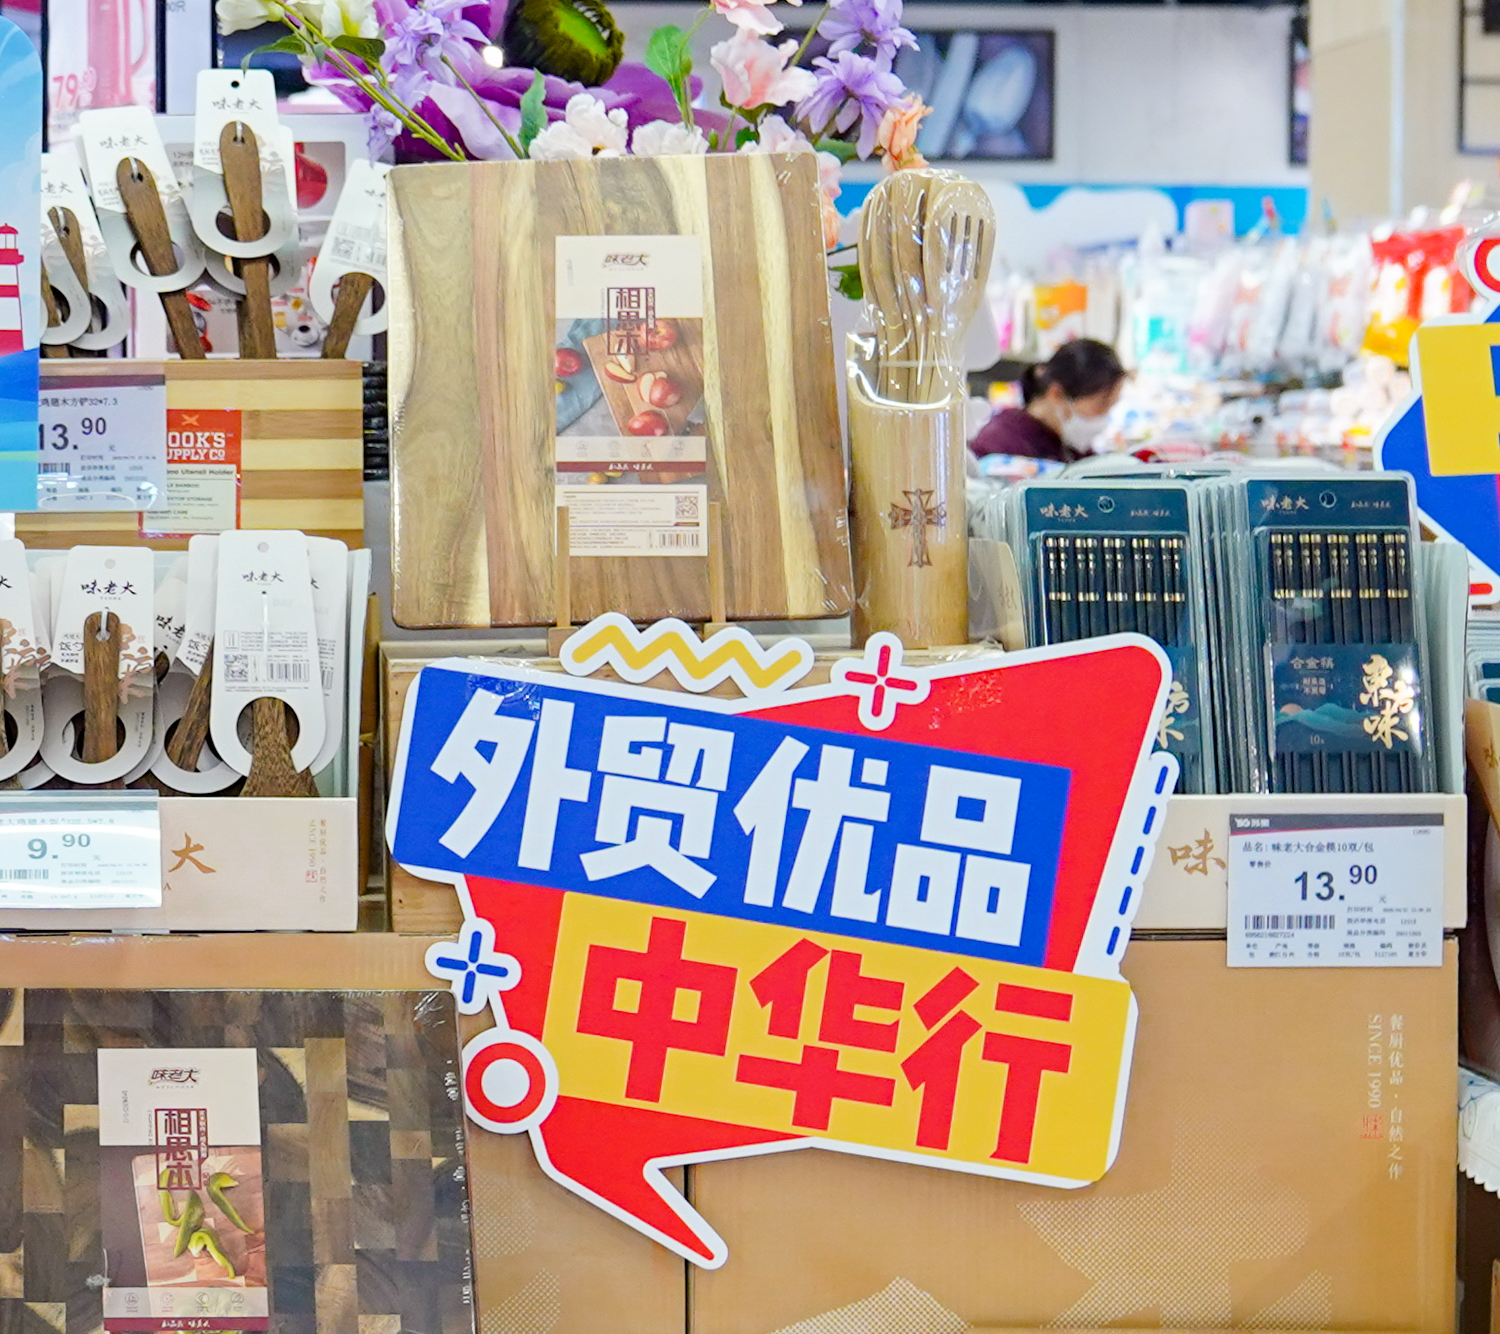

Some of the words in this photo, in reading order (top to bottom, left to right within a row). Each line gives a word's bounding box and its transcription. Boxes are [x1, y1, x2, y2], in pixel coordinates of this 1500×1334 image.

[212, 96, 263, 112] 味老大
[99, 136, 148, 149] 味老大
[1039, 502, 1089, 520] 味老大
[1260, 495, 1310, 514] 味老大
[242, 570, 284, 584] 味老大
[81, 578, 138, 596] 味老大
[429, 687, 1032, 947] 外贸优品
[27, 833, 91, 860] 9.90
[576, 916, 1073, 1164] 中华行
[1368, 1014, 1383, 1065] SINCE
[1368, 1072, 1383, 1108] 1990
